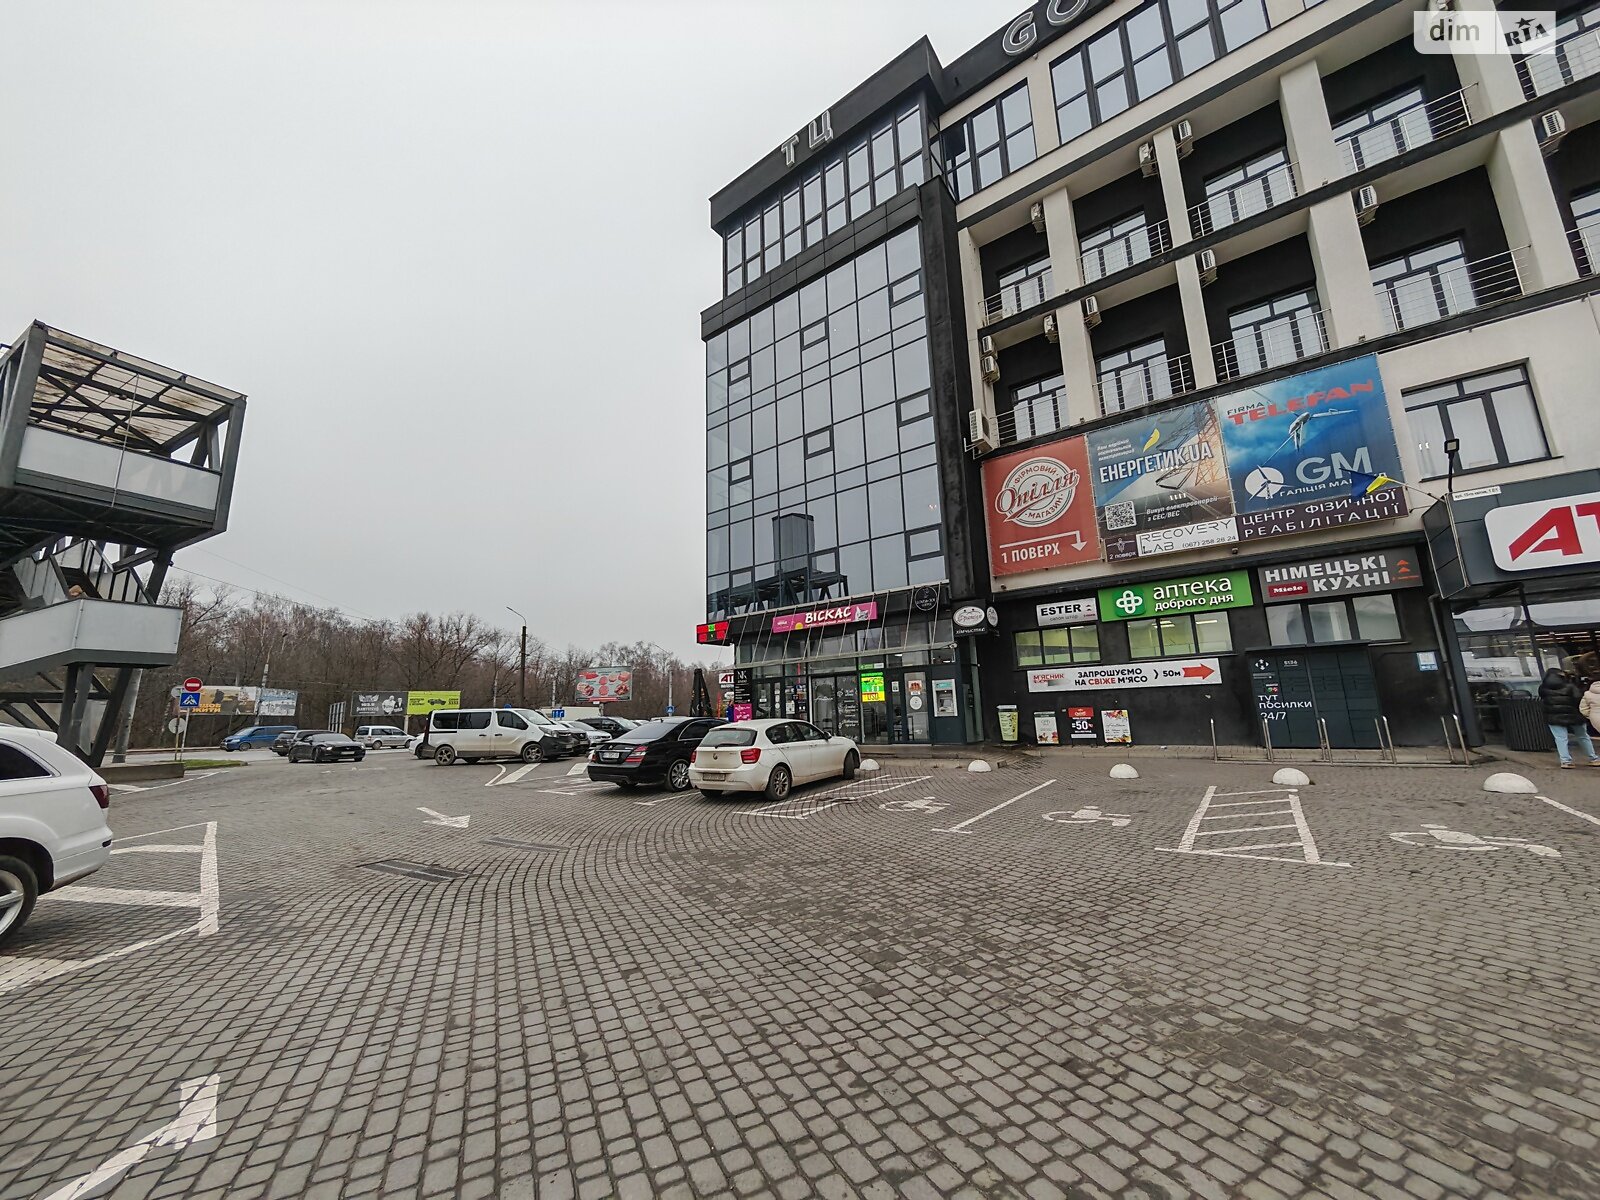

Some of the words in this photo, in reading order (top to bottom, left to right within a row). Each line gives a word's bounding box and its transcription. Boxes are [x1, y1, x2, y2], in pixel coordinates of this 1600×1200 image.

[780, 109, 834, 168] ТЦ
[1226, 401, 1264, 416] FIRMA
[1227, 379, 1374, 426] TELEFAN
[1014, 465, 1057, 483] ФІРМОВИЙ
[1295, 446, 1373, 485] GM
[996, 469, 1079, 514] Опілля
[1028, 497, 1062, 519] МАГАЗИН
[1242, 508, 1296, 526] ЦЕНТР
[1243, 502, 1401, 538] РЕАБІЛІТАЦІЇ
[1140, 519, 1232, 543] RECOVERY
[1001, 553, 1008, 563] 1
[1011, 542, 1060, 562] ПОВЕРХ
[1265, 555, 1387, 583] НІМЕЦЬКІ
[1152, 577, 1232, 600] аптека
[1273, 585, 1304, 594] Miele
[1313, 571, 1391, 593] КУХНІ
[1040, 604, 1082, 617] ESTER
[1154, 597, 1206, 612] доброго
[1209, 593, 1234, 606] дня
[805, 607, 852, 624] ВІСКАС
[1077, 668, 1143, 680] ЗАПРОШУЄМО
[1088, 678, 1116, 686] СВІЖЕ
[1117, 676, 1148, 685] М'ЯСО
